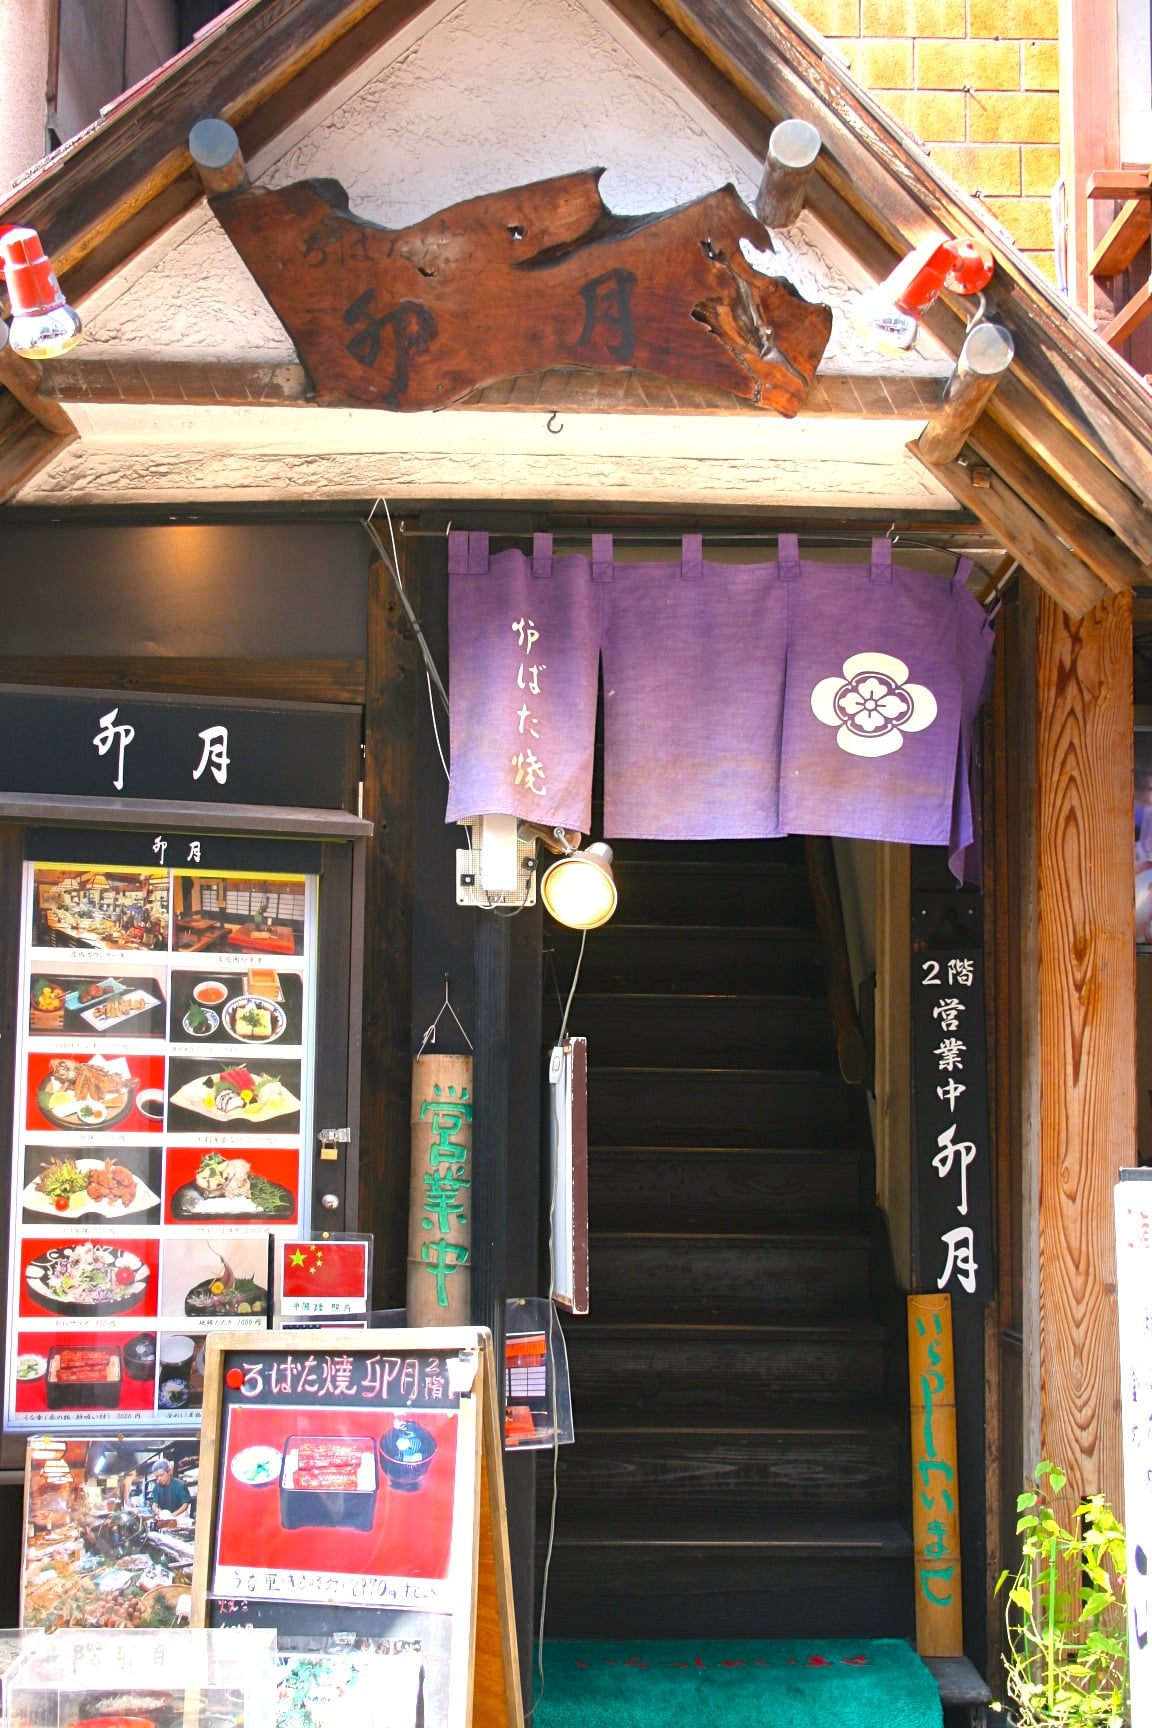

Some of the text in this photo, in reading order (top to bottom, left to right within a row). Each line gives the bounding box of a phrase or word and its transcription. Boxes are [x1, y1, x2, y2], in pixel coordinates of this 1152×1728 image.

[92, 707, 231, 791] 卯月
[152, 836, 202, 865] 卯月
[420, 1084, 473, 1307] 営業中
[237, 1319, 262, 1327] 1000円
